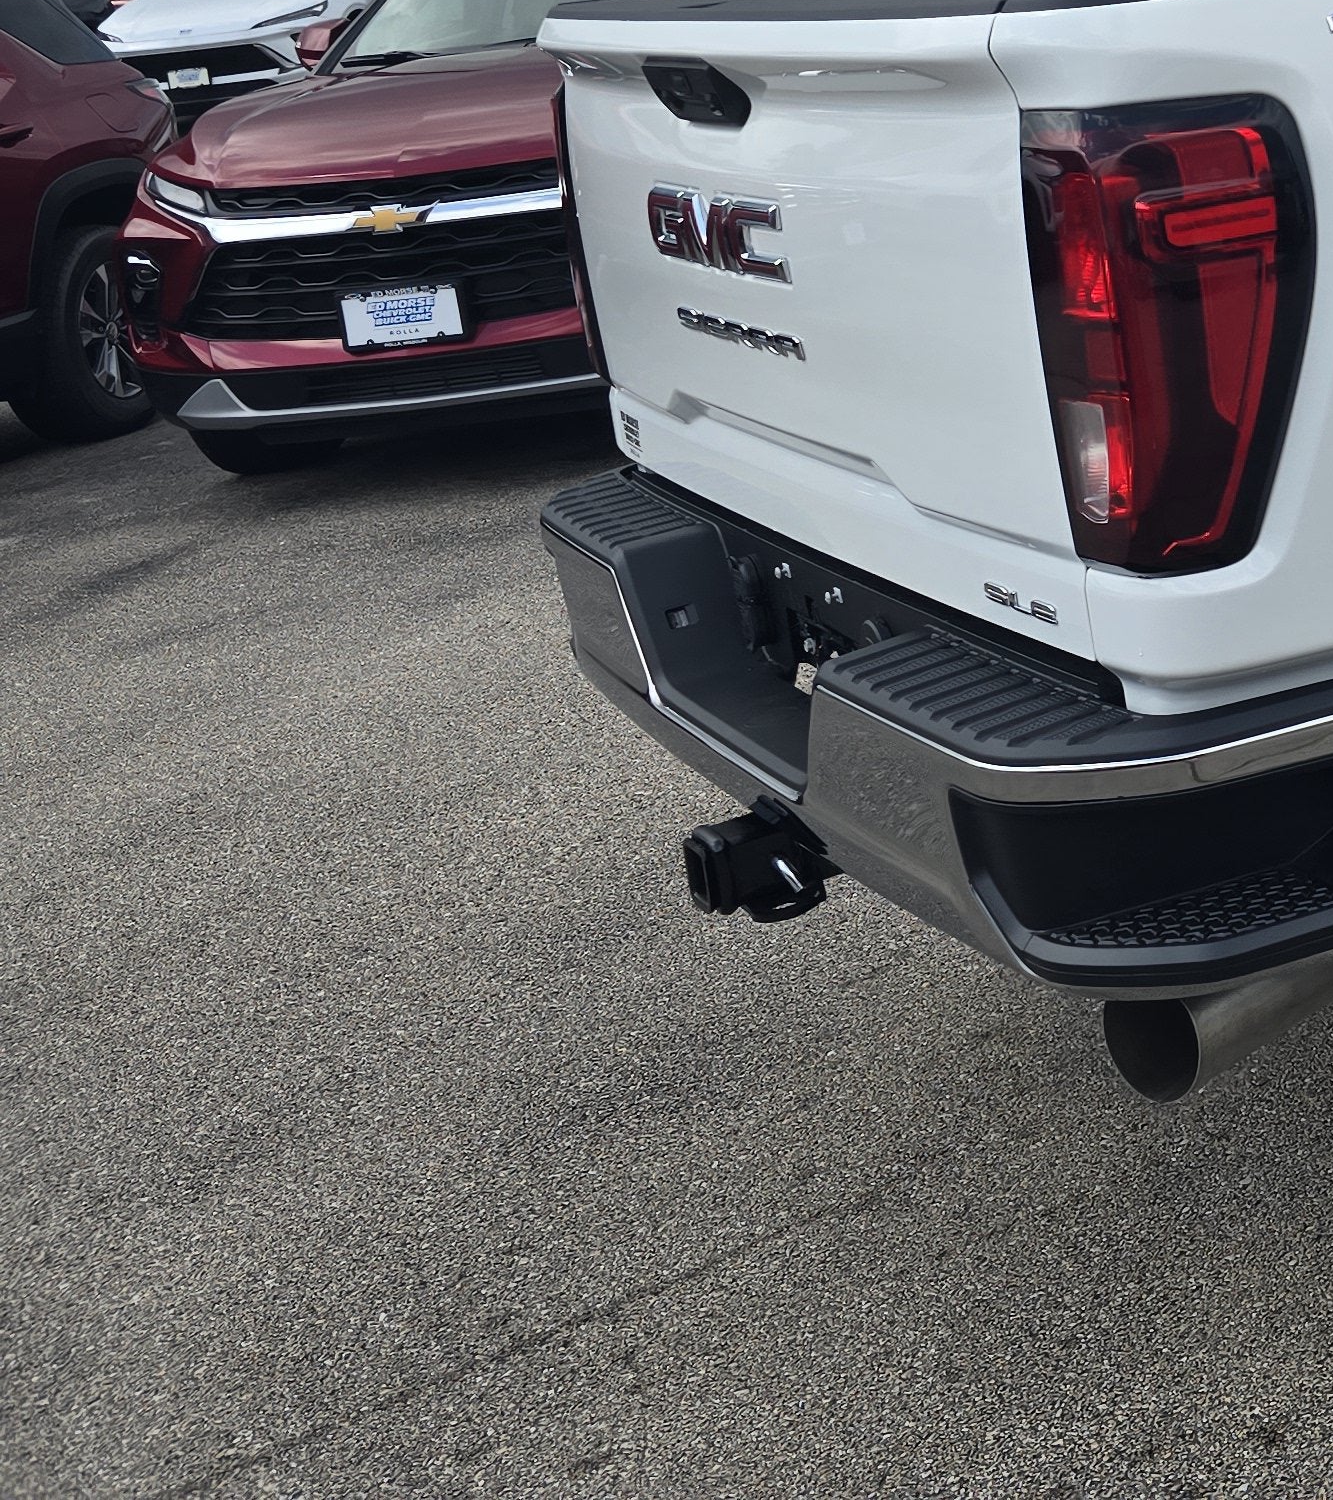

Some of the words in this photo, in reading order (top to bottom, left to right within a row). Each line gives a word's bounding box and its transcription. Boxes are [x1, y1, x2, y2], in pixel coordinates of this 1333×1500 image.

[647, 185, 793, 285] GMC
[367, 301, 385, 312] ED
[386, 296, 434, 310] MORSE
[385, 286, 418, 297] MORSE
[373, 306, 431, 319] CHEVROLET
[677, 306, 806, 361] SIERRA
[984, 582, 1058, 625] SLE
